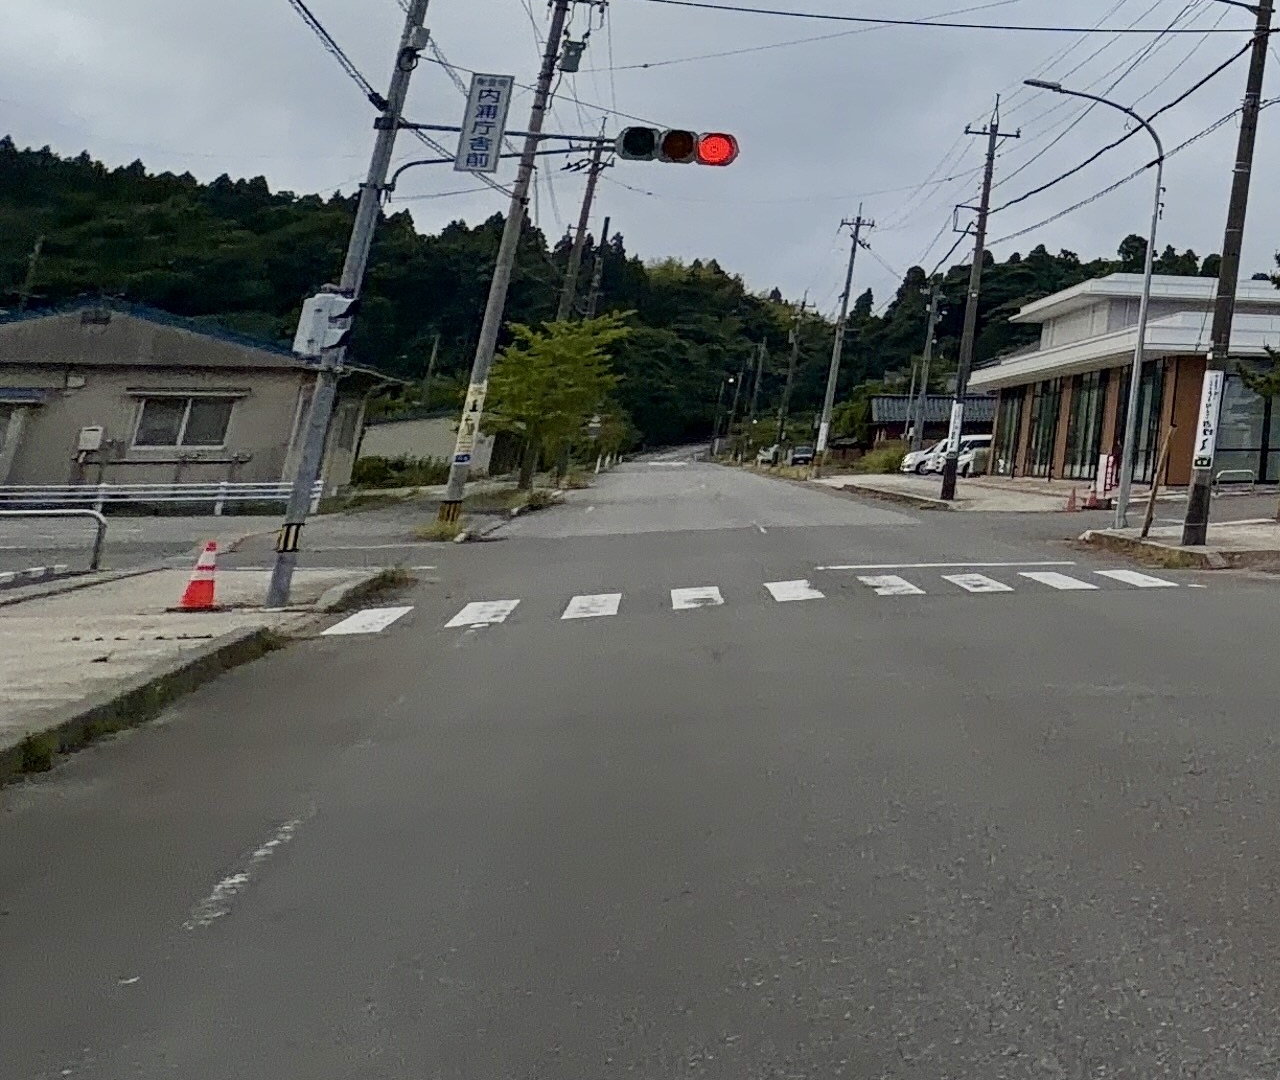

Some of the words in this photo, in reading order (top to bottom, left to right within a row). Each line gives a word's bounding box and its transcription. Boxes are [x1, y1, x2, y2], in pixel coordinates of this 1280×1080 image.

[466, 88, 501, 168] 内浦庁舎前
